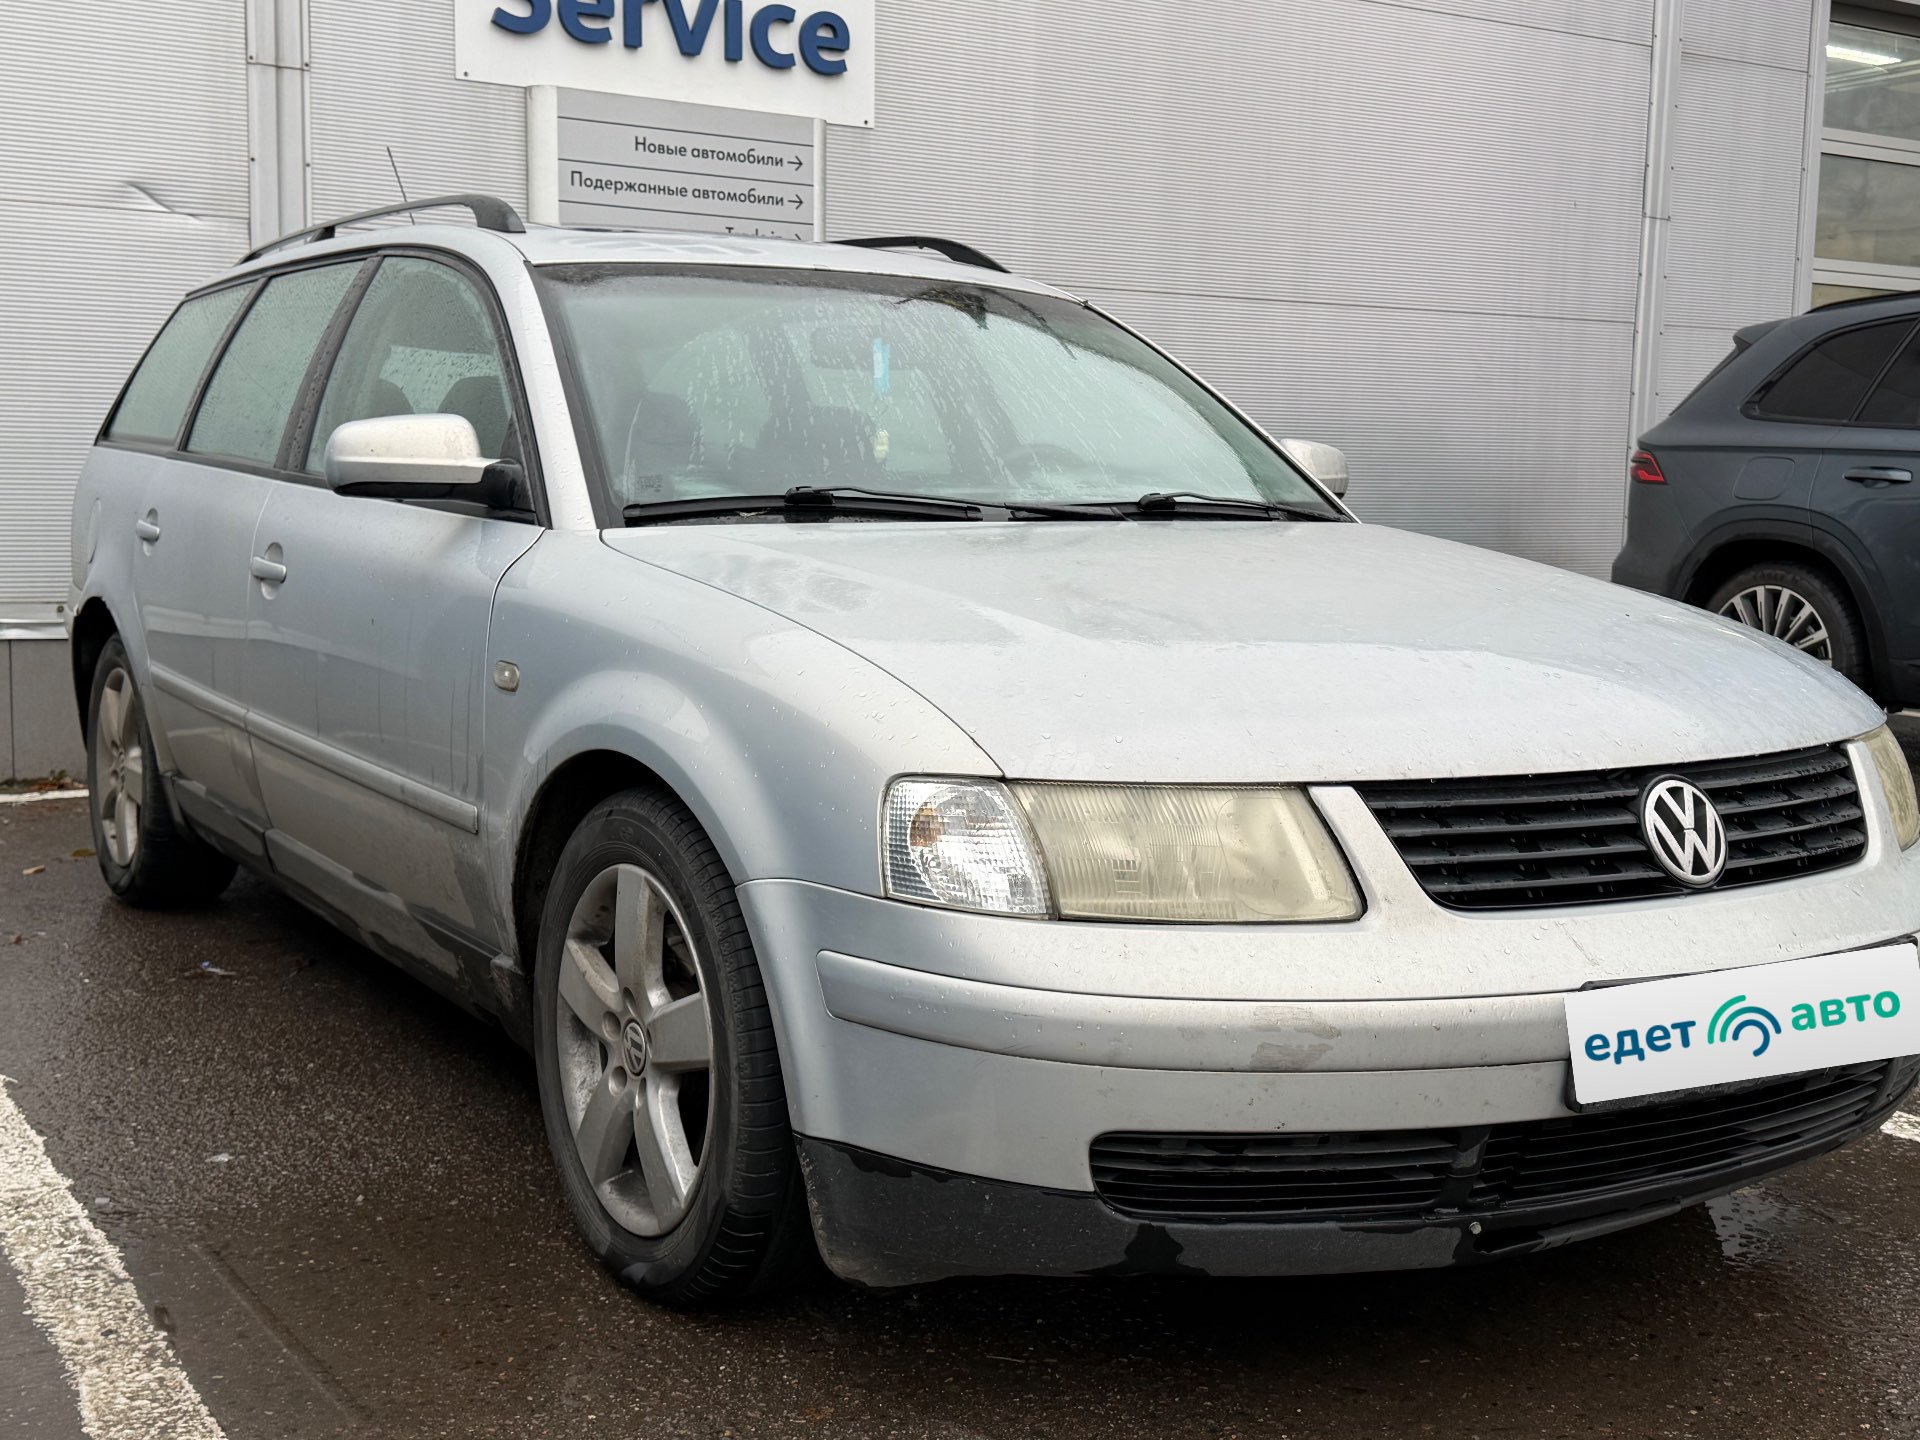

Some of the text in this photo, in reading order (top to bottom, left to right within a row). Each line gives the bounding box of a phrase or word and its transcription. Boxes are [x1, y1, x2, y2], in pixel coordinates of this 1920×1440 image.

[634, 135, 784, 168] Новые автомобили
[570, 170, 785, 207] Подержанные автомобили
[1645, 780, 1726, 884] VW
